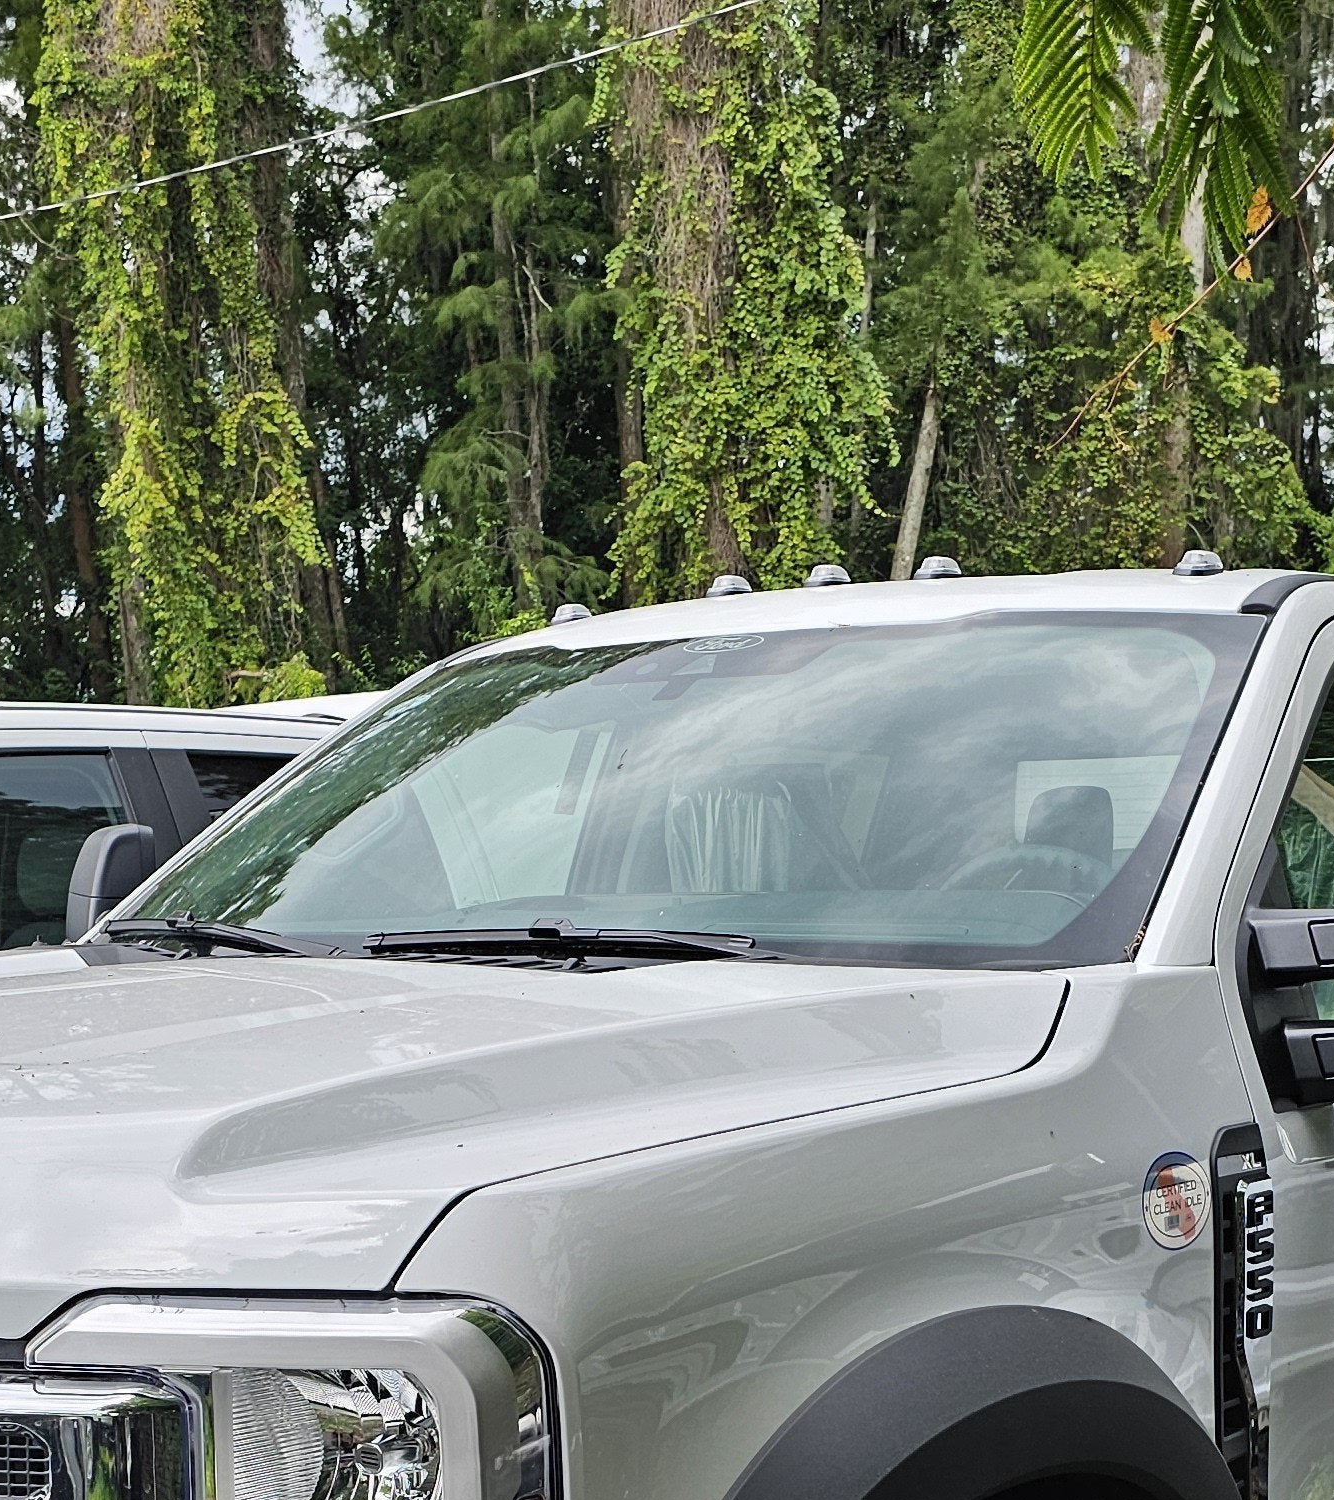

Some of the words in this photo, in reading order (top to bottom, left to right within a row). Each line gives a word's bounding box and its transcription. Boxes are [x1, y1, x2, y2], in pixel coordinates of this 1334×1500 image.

[1241, 1152, 1262, 1170] XL
[1156, 1179, 1197, 1198] CERTIFIED
[1153, 1199, 1182, 1216] CLEAN
[1184, 1193, 1203, 1209] IDLE
